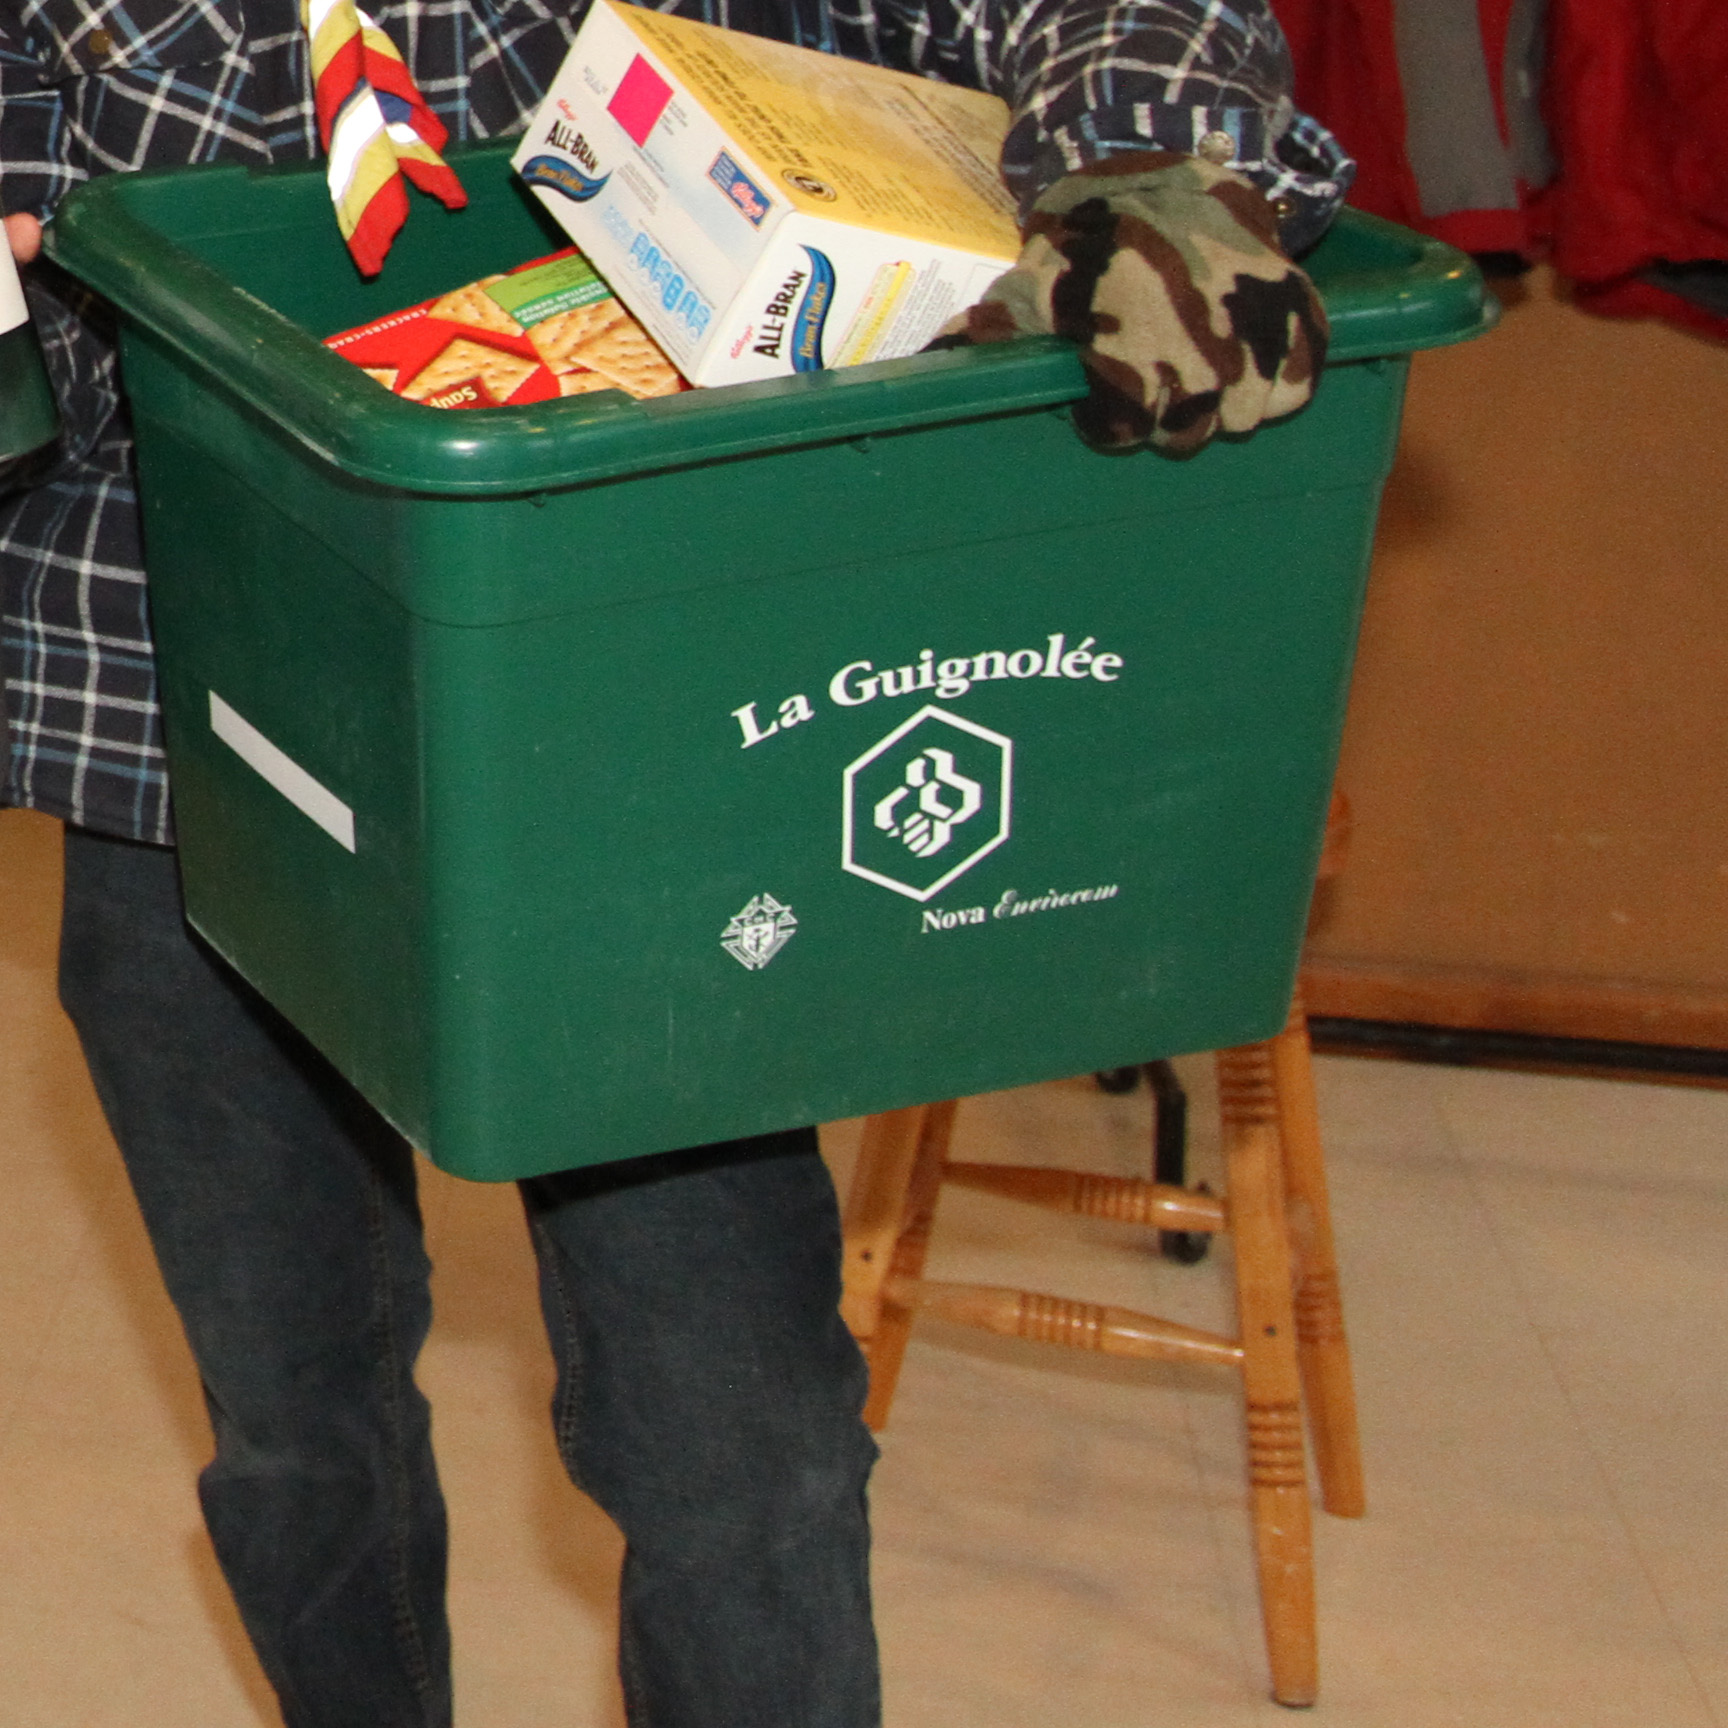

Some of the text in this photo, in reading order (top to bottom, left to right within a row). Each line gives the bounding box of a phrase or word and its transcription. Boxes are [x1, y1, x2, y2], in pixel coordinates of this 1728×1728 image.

[544, 119, 600, 175] ALL-BRAN
[752, 269, 808, 360] ALL-BRAN
[730, 632, 1124, 749] La Guignolée
[920, 905, 986, 934] Nova
